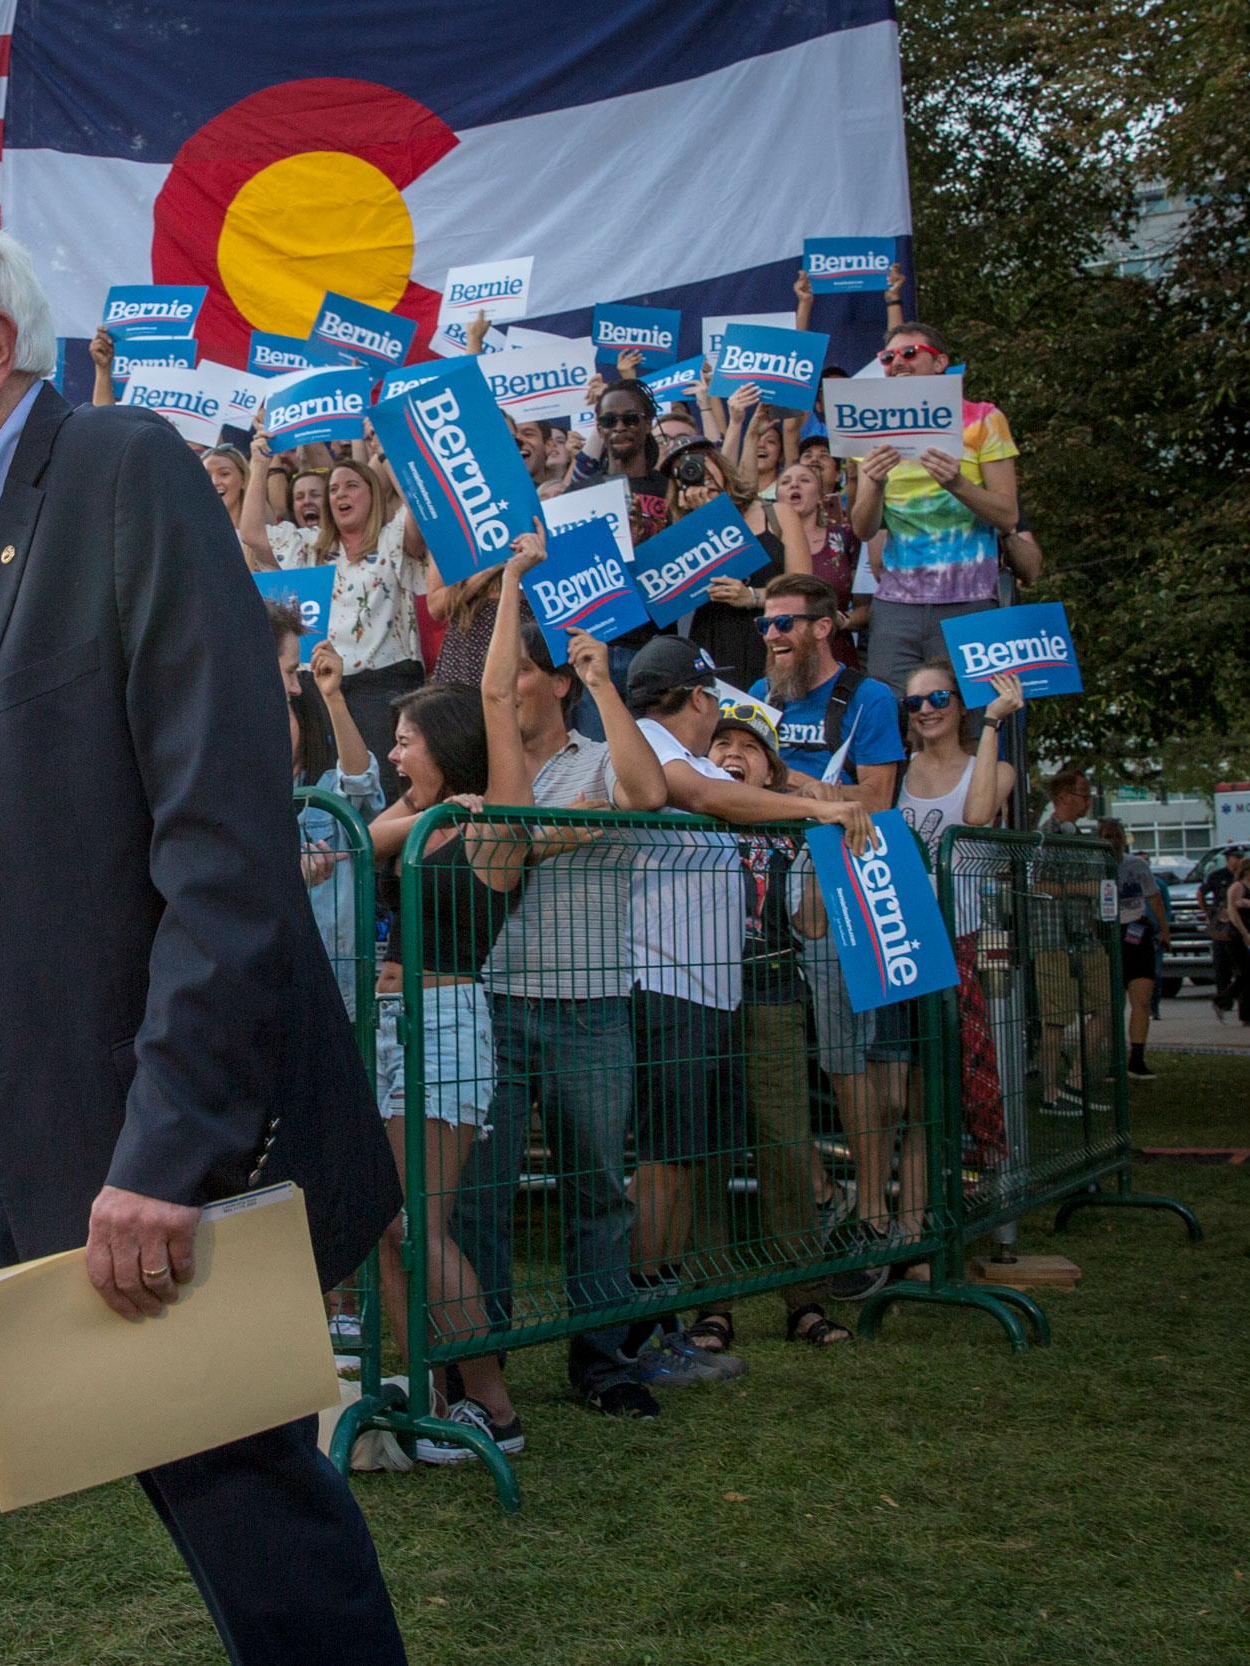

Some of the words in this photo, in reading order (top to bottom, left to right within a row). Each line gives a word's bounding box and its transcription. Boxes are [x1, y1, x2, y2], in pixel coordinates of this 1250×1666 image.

[809, 251, 889, 273] Bernie
[450, 276, 523, 301] Bernie
[107, 300, 193, 320] Bernie
[319, 311, 402, 358] Bernie
[598, 321, 673, 347] Bernie
[254, 345, 308, 368] Bern
[721, 345, 814, 381] Bernie
[489, 363, 588, 398] Bernie
[129, 386, 219, 417] Bernie
[269, 389, 363, 428] Bernie
[834, 400, 952, 430] Bernie
[415, 387, 510, 551] Bernie
[636, 526, 744, 598] Bernie
[533, 555, 624, 620] Bernie
[958, 630, 1067, 673] Bernie
[778, 720, 826, 744] erni
[859, 826, 921, 987] Bernie
